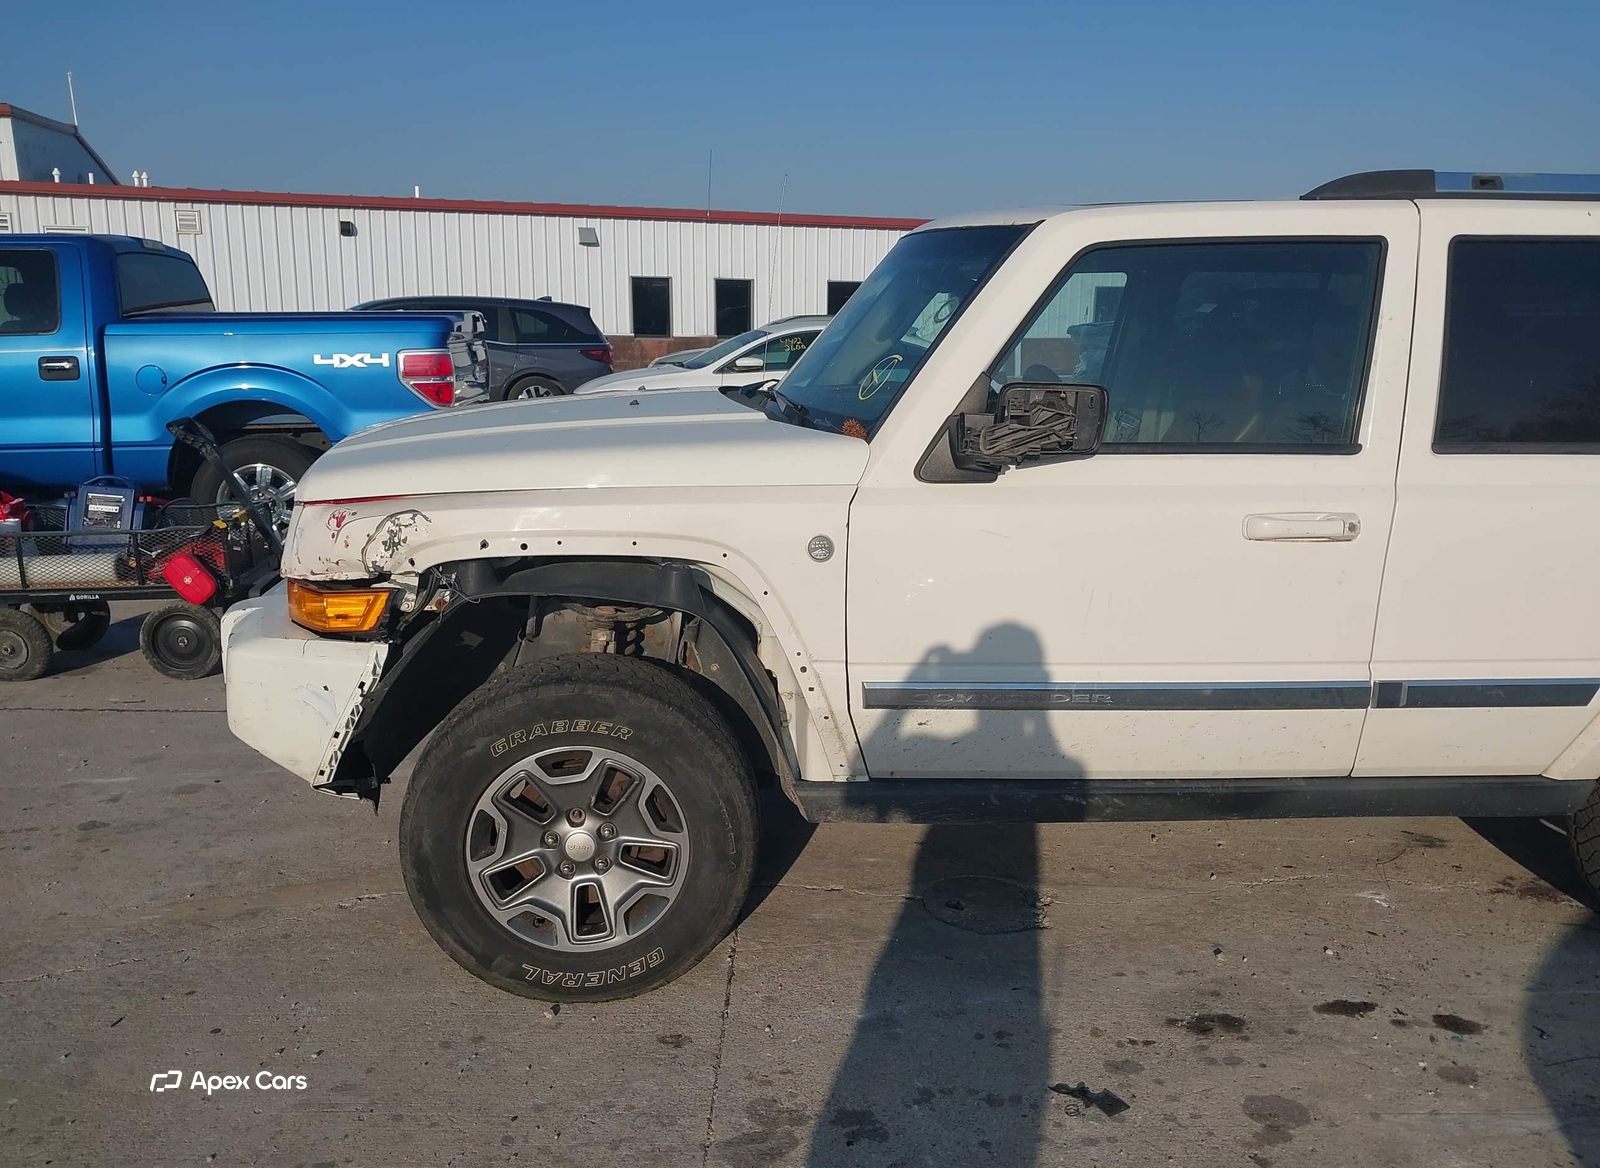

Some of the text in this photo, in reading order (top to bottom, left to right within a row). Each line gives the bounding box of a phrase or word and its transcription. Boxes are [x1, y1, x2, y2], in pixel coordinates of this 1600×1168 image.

[313, 352, 390, 368] 4X4
[910, 693, 1113, 704] COMMANDER
[490, 719, 634, 757] GRABBER
[521, 946, 665, 988] GENERAL
